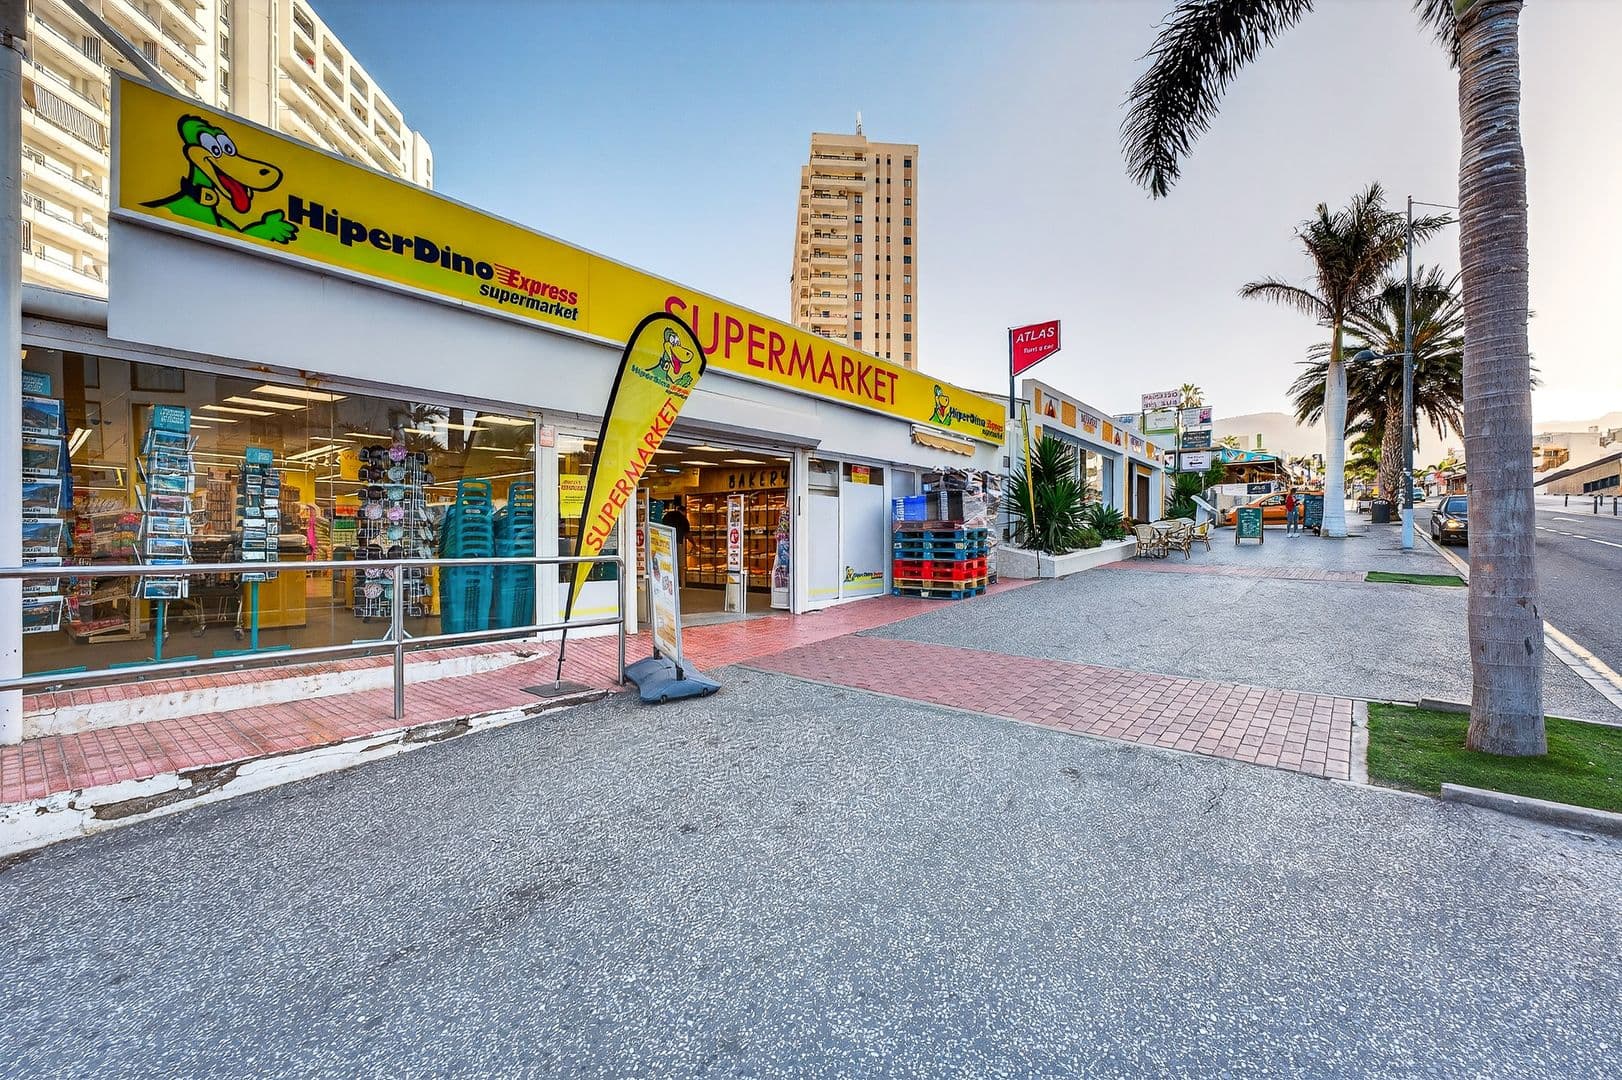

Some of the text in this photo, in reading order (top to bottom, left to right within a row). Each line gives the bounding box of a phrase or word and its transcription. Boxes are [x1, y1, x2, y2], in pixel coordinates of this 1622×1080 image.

[288, 194, 578, 305] HiperDino Express
[480, 283, 579, 321] supermarket
[1015, 327, 1055, 343] ATLAS
[949, 406, 986, 428] HiperDino
[586, 397, 679, 551] SUPERMARKET
[729, 469, 788, 489] BAKERY
